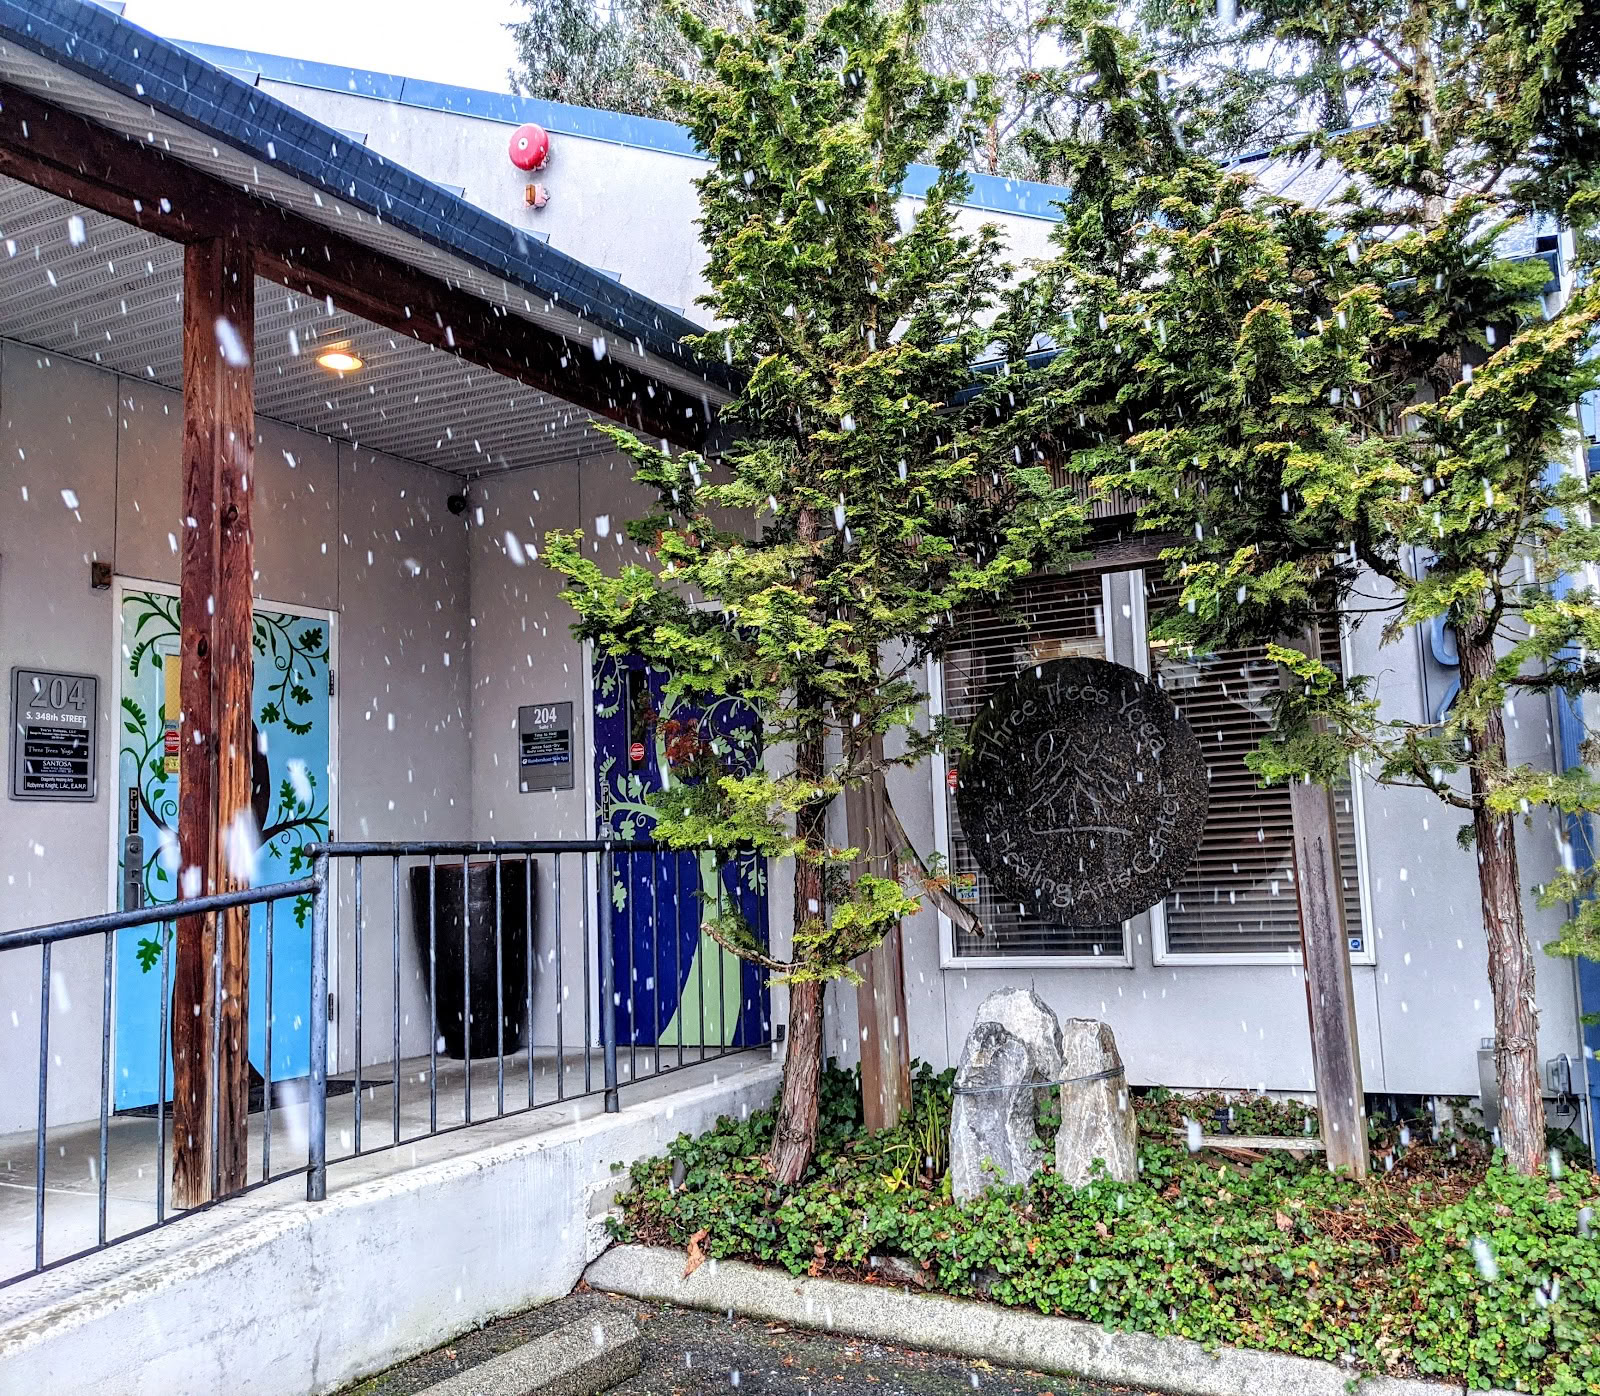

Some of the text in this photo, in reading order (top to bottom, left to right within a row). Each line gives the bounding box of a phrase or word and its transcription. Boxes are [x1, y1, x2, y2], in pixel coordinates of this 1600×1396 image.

[30, 677, 86, 710] 204
[26, 711, 87, 723] S. 348th STREET
[534, 707, 557, 724] 204
[980, 683, 1166, 761] Three Trees Yoga
[44, 746, 59, 754] Trees
[60, 747, 74, 756] Yoga
[130, 789, 138, 832] PULL
[992, 829, 1072, 907] Healing
[1077, 872, 1131, 901] Arts
[1132, 784, 1178, 874] Center
